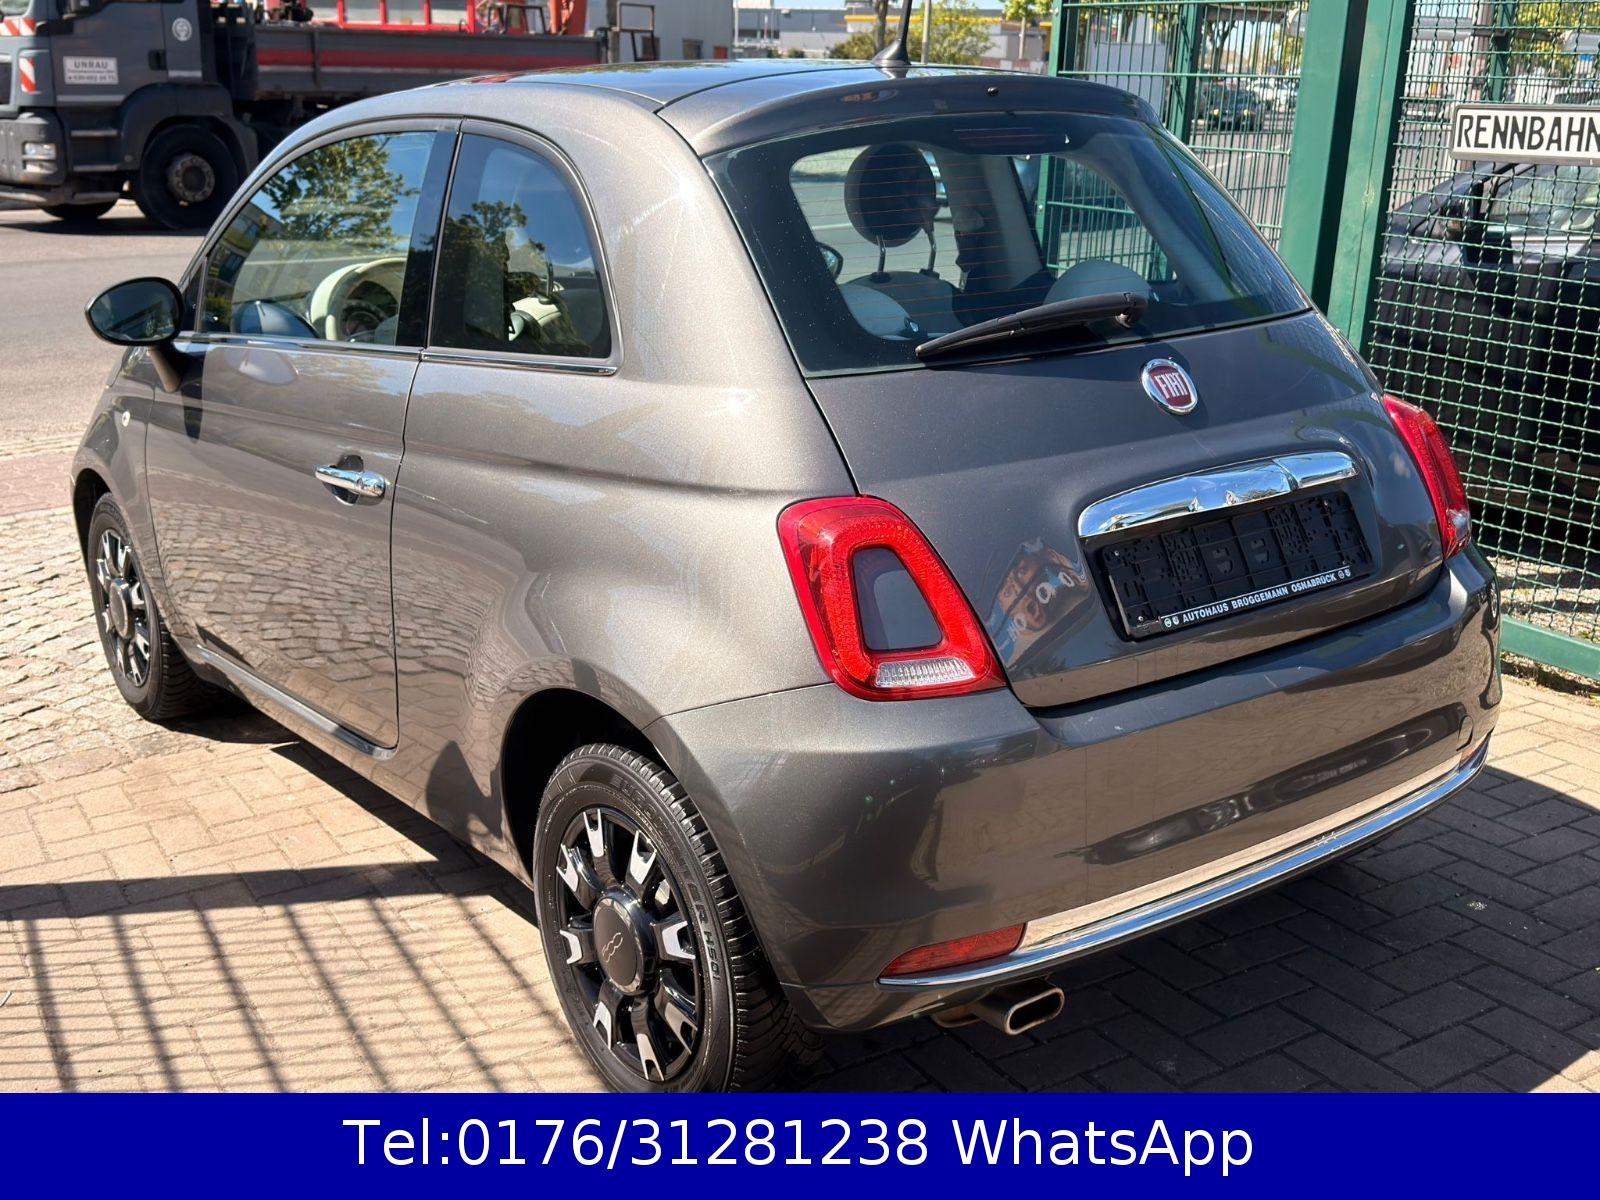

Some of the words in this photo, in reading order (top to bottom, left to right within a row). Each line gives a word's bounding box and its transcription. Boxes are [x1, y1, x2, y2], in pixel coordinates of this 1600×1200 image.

[1154, 372, 1189, 399] FIAT
[1182, 603, 1230, 624] AUTOHAUS
[1291, 573, 1338, 593] OSNABRÜCK
